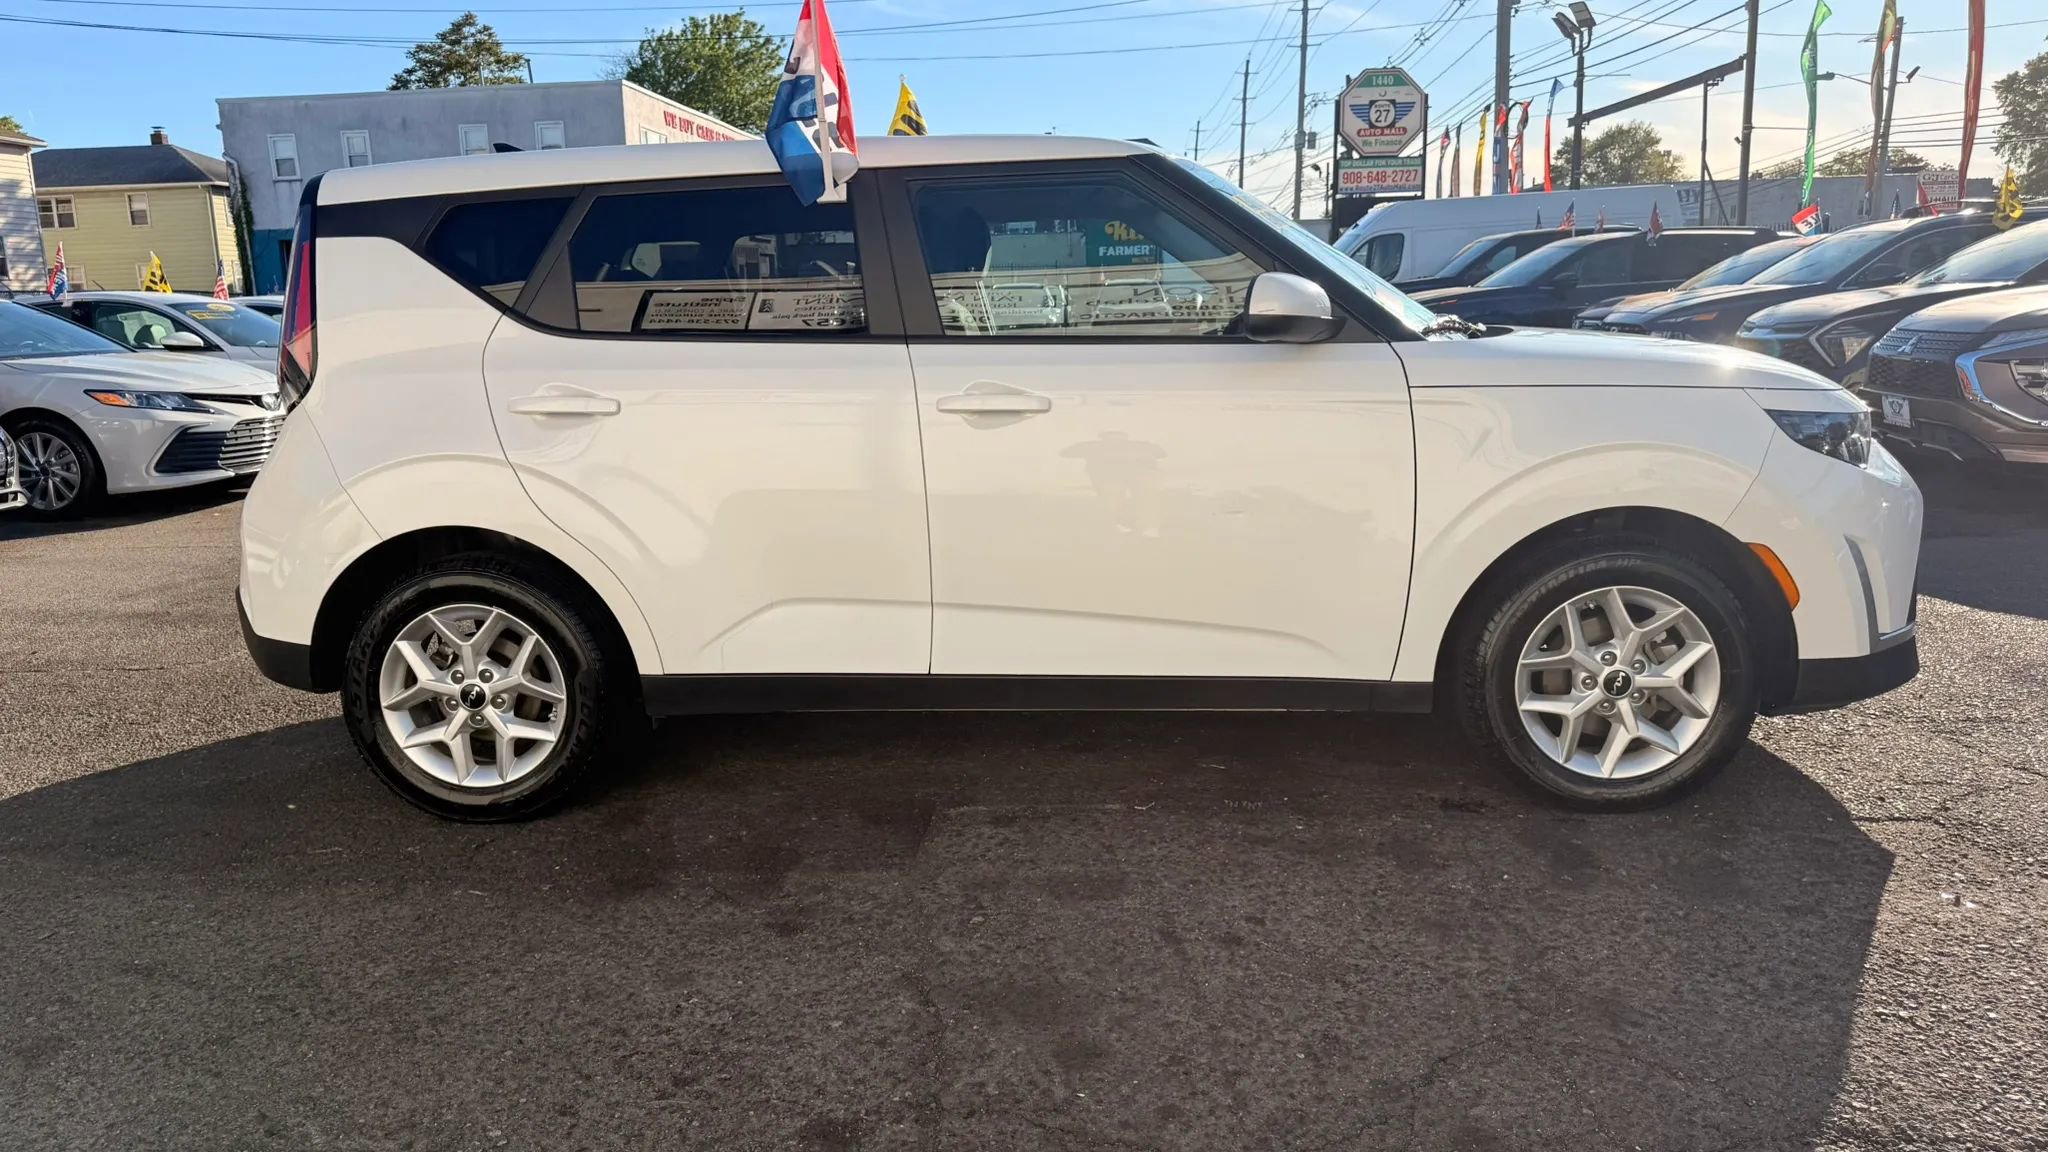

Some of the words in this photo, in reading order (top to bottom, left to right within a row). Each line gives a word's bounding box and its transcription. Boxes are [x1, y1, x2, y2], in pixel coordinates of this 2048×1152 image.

[1372, 76, 1394, 85] 1440
[1374, 109, 1390, 123] 27
[663, 110, 677, 129] WE
[679, 117, 694, 135] BUY
[1359, 128, 1381, 137] AUTO
[1384, 127, 1405, 136] MALL
[1374, 138, 1402, 147] Finance
[1352, 159, 1374, 167] DOLLAR
[1342, 168, 1418, 185] 908-648-2727
[1098, 245, 1155, 256] FARMER
